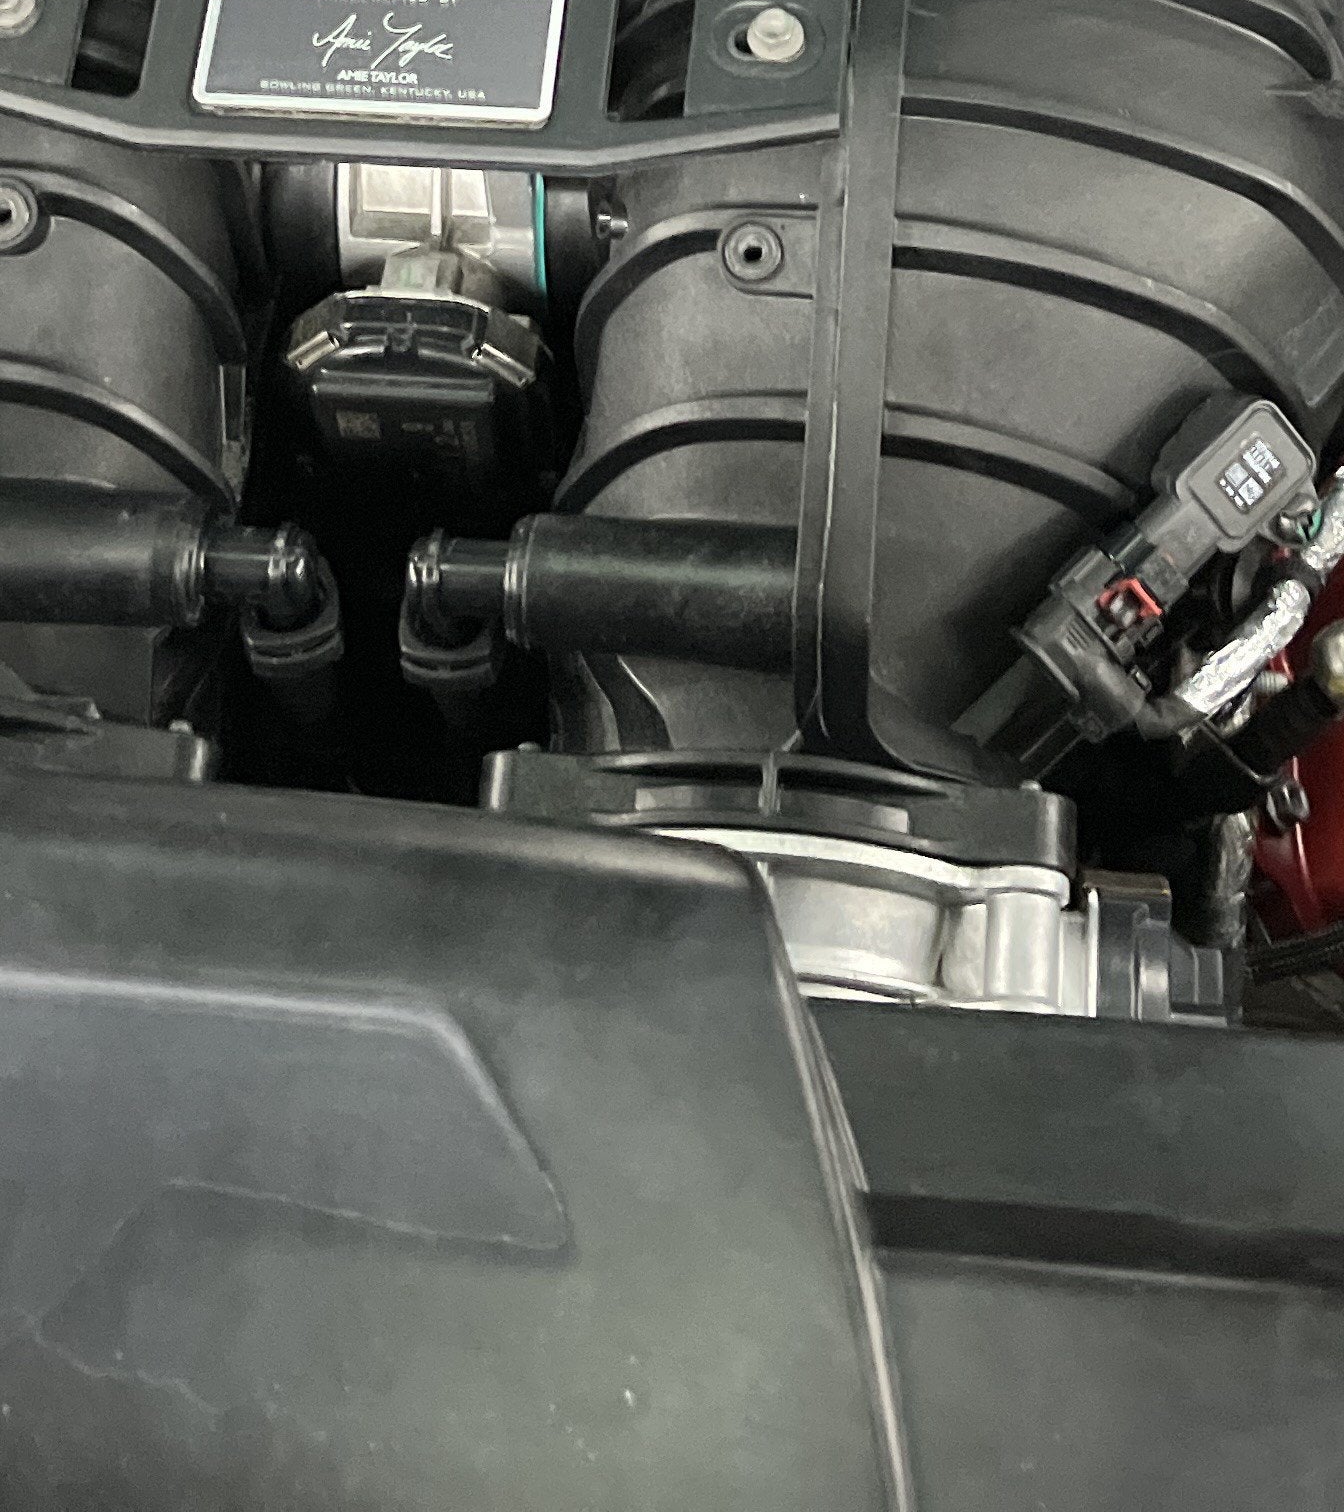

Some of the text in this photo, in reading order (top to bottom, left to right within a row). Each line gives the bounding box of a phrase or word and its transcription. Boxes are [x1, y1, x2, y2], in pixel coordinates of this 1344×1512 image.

[336, 69, 419, 85] AMIE TAYLOR
[259, 79, 322, 93] BOWLING
[457, 90, 486, 100] USA
